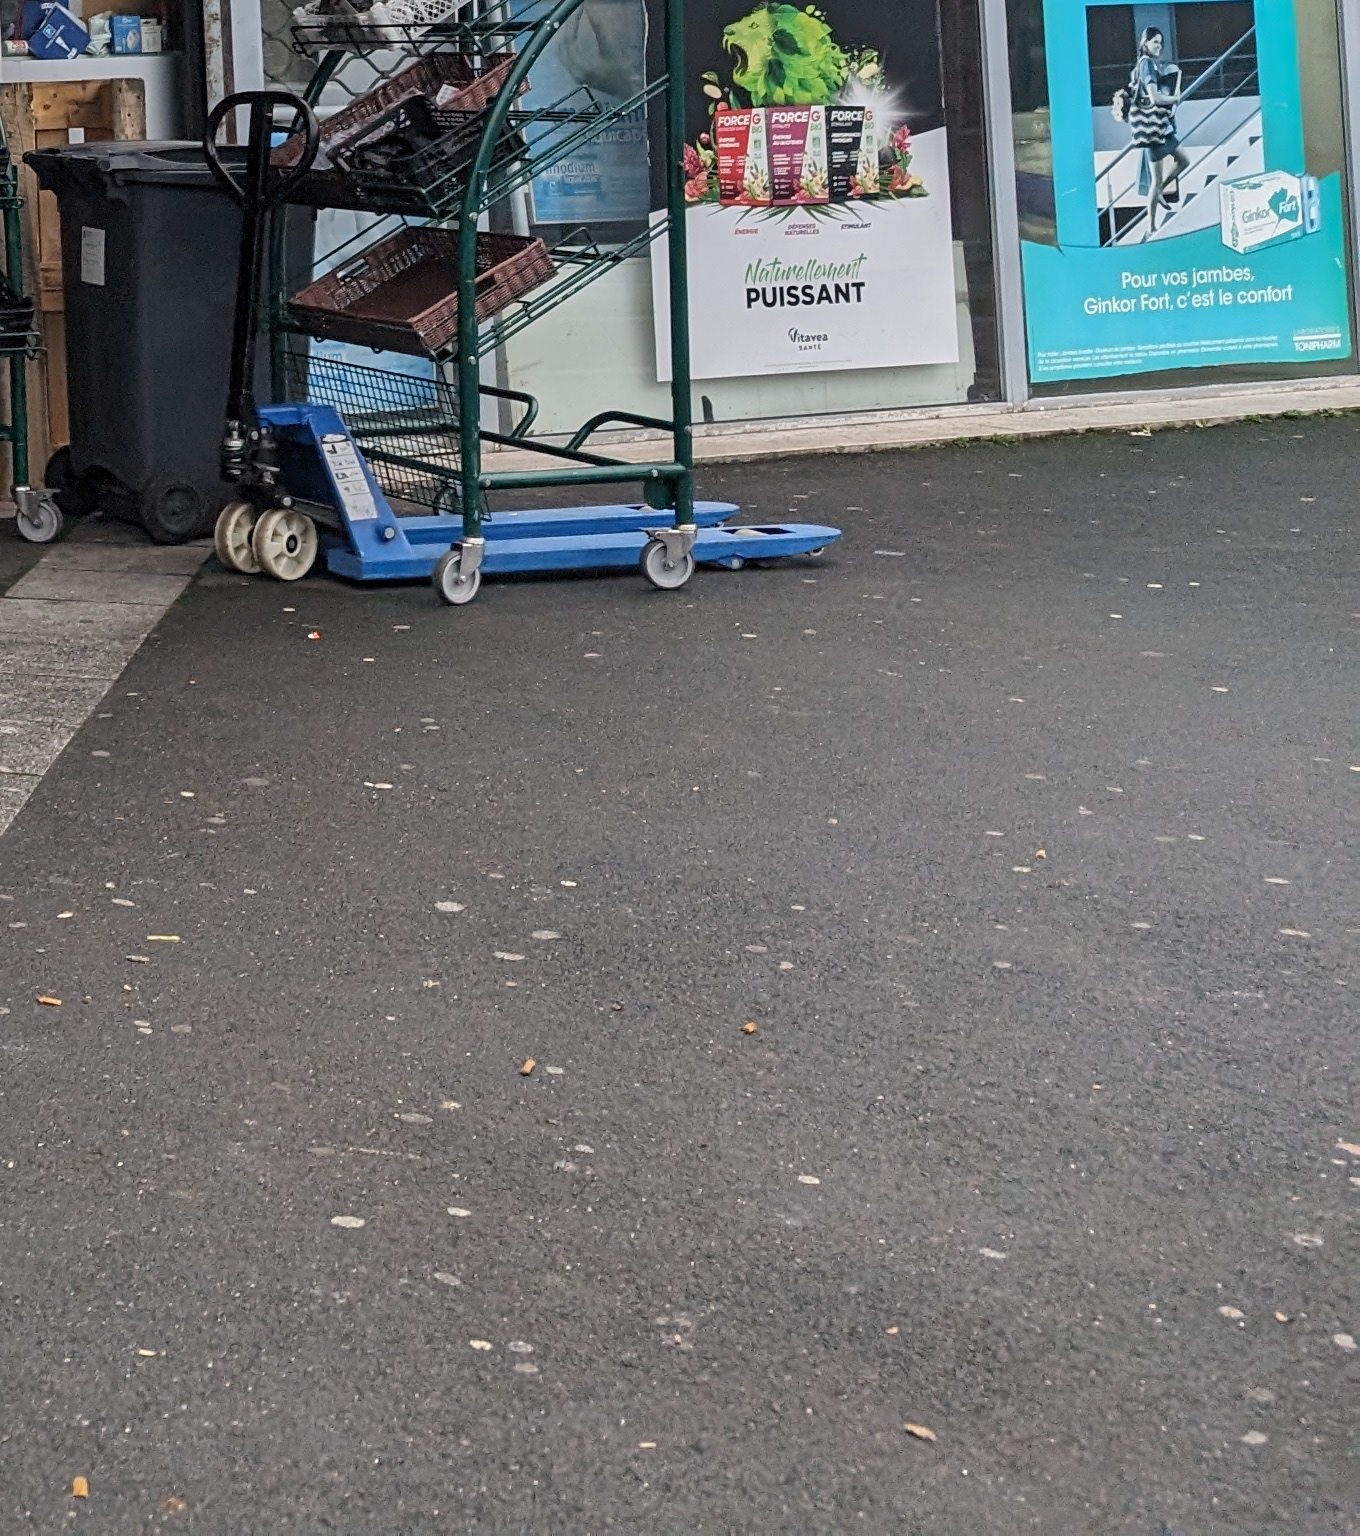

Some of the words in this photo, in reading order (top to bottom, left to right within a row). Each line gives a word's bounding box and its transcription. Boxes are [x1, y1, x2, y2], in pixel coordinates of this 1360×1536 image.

[718, 115, 751, 127] FORCE
[772, 111, 809, 123] FORCE
[831, 110, 864, 121] FORCE
[745, 253, 868, 285] Naturellement
[1121, 270, 1157, 289] Pour
[1162, 271, 1188, 286] vos
[1191, 265, 1255, 288] jambes,
[746, 282, 866, 309] PUISSANT
[1083, 296, 1136, 315] Ginkor
[1140, 294, 1174, 313] Fort,
[1176, 290, 1214, 309] c'est
[1219, 288, 1233, 305] le
[1237, 284, 1293, 304] confort
[788, 327, 829, 342] Vitavea
[1294, 339, 1342, 352] TONIPHARM
